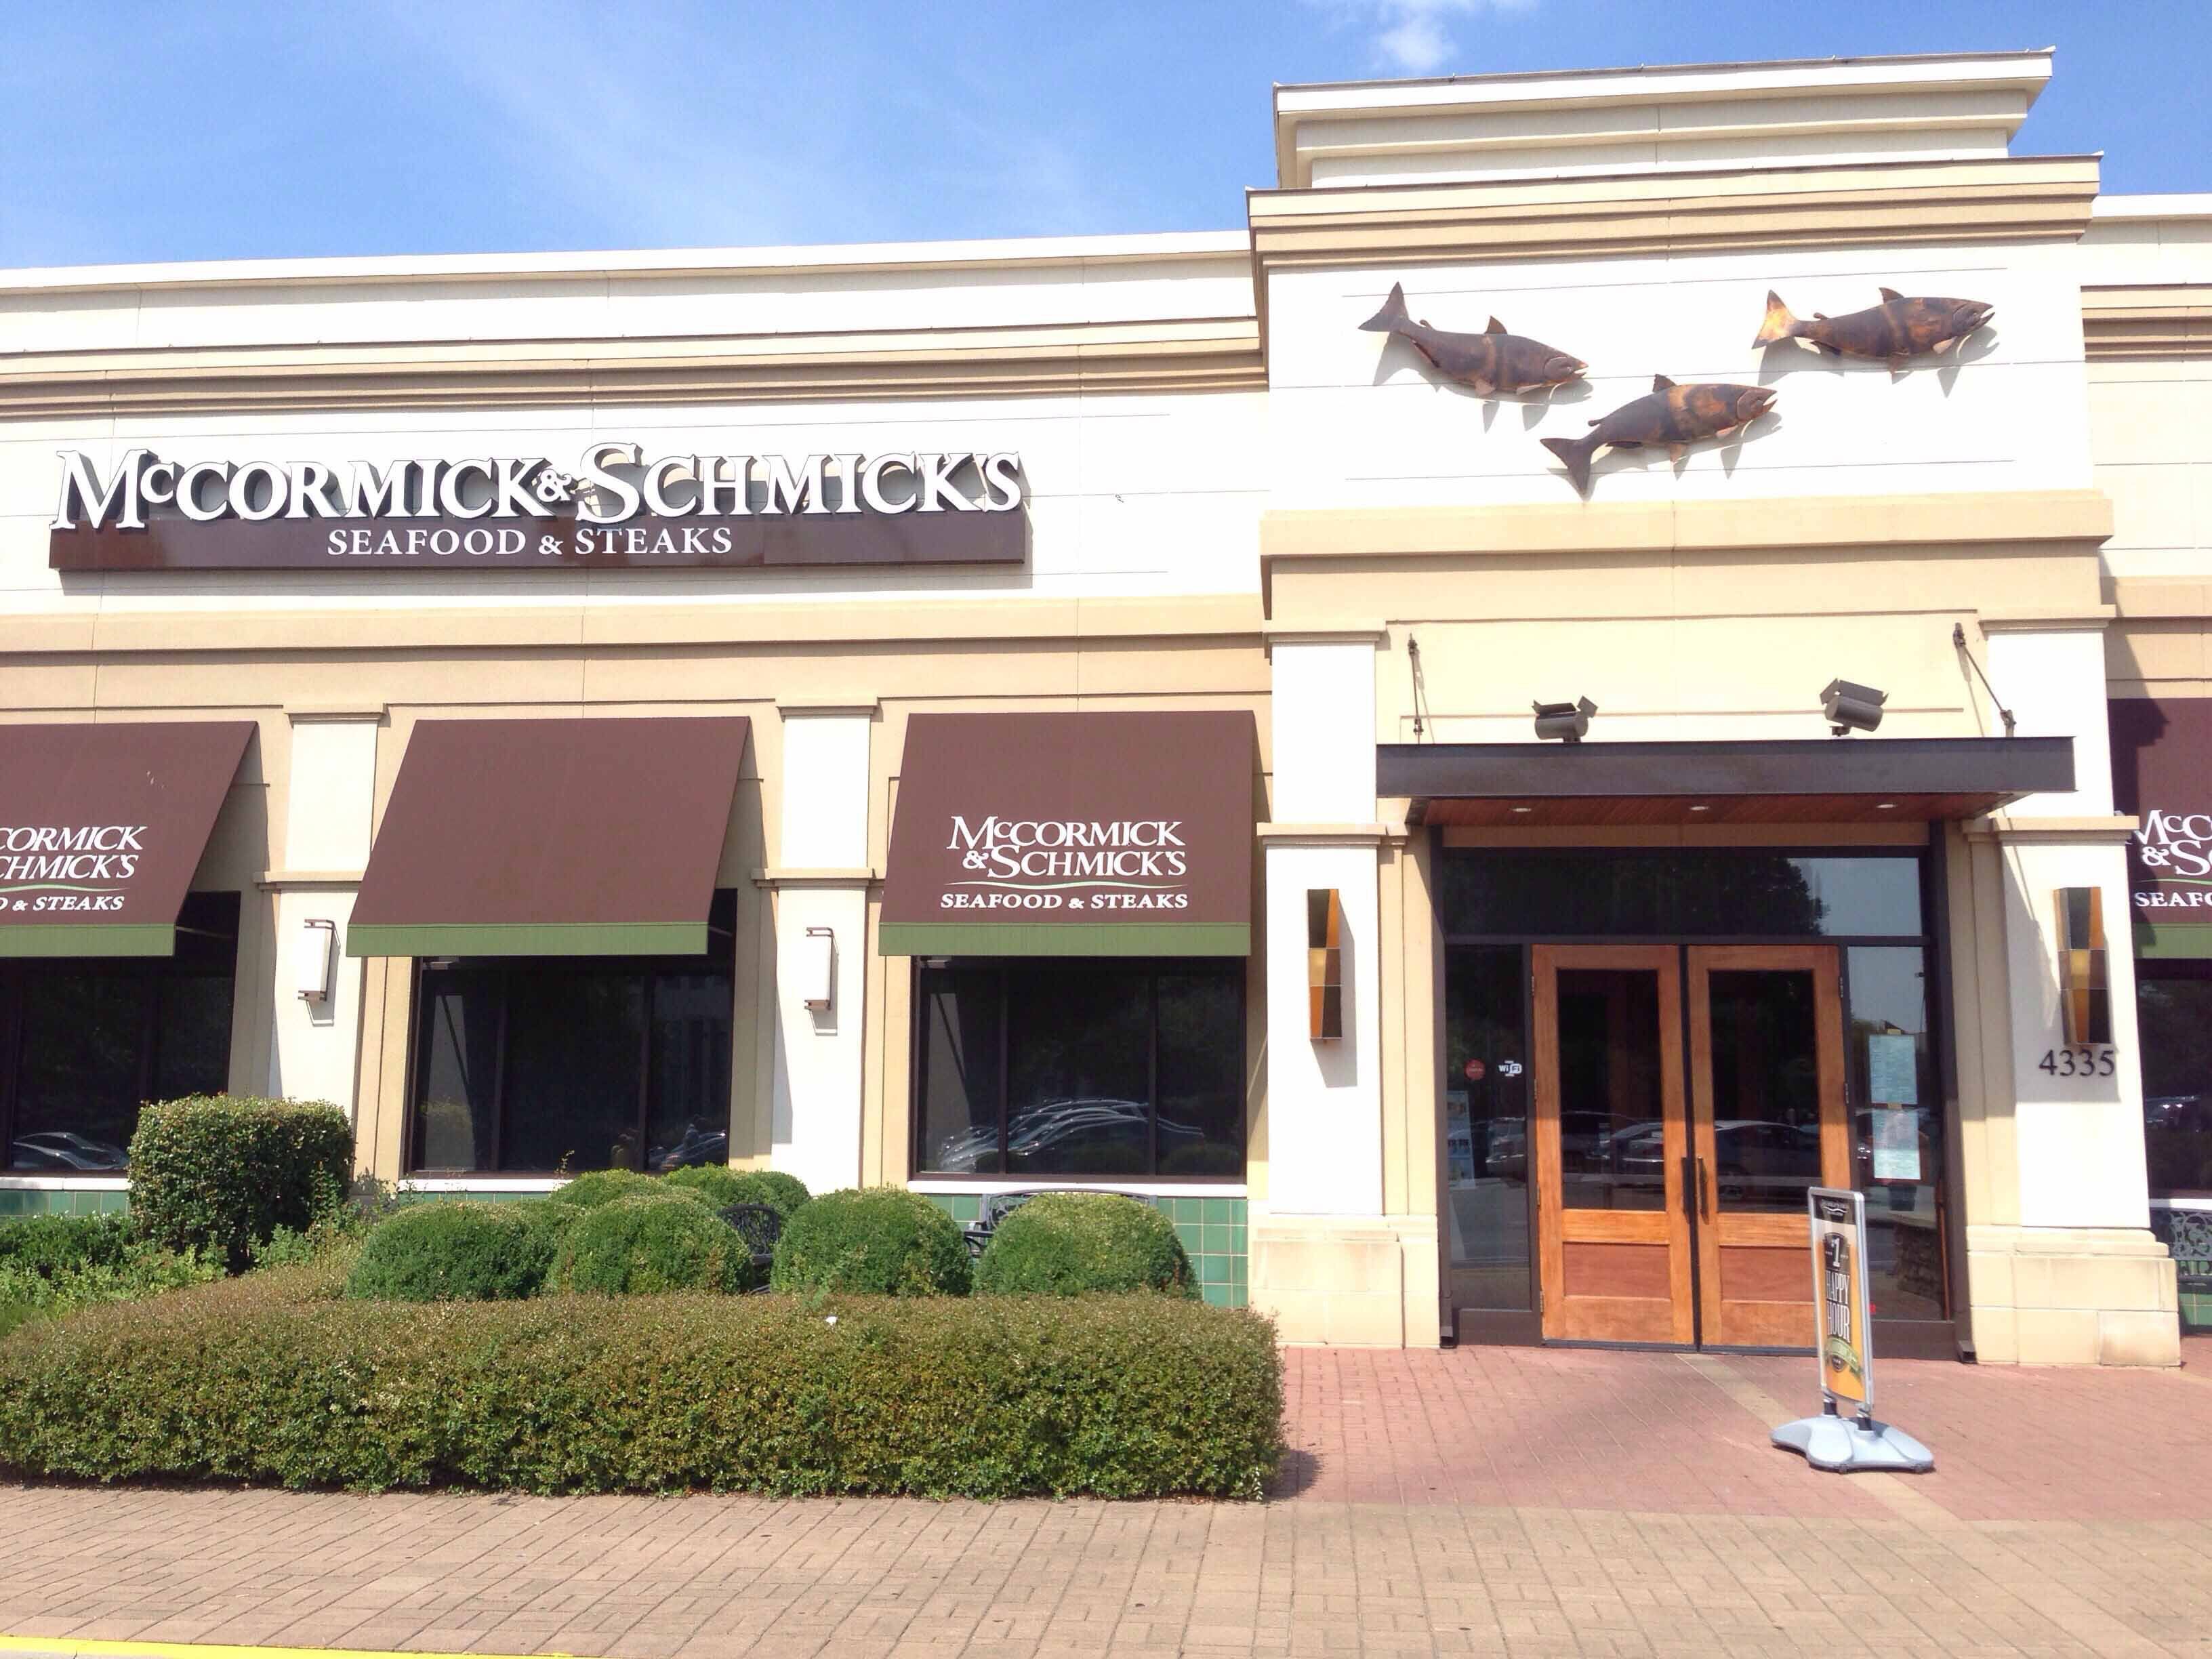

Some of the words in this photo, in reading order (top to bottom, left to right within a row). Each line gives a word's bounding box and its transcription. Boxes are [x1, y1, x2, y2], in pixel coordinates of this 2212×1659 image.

[49, 448, 554, 530] McCORMICK
[536, 468, 572, 502] &
[575, 442, 1022, 524] SCHMICK'S
[327, 529, 527, 556] SEAFOOD
[538, 535, 563, 555] &
[575, 527, 733, 555] STEAKS
[946, 815, 1186, 850] McCORMICK
[2170, 840, 2212, 876] S
[12, 899, 28, 912] &
[33, 895, 125, 912] STEAKS
[940, 893, 1063, 909] SEAFOOD
[1068, 898, 1085, 909] &
[1090, 893, 1189, 909] STEAKS
[2039, 1048, 2115, 1077] 4335
[1826, 1270, 1850, 1305] HAPPY
[1827, 1300, 1851, 1344] HOUR
